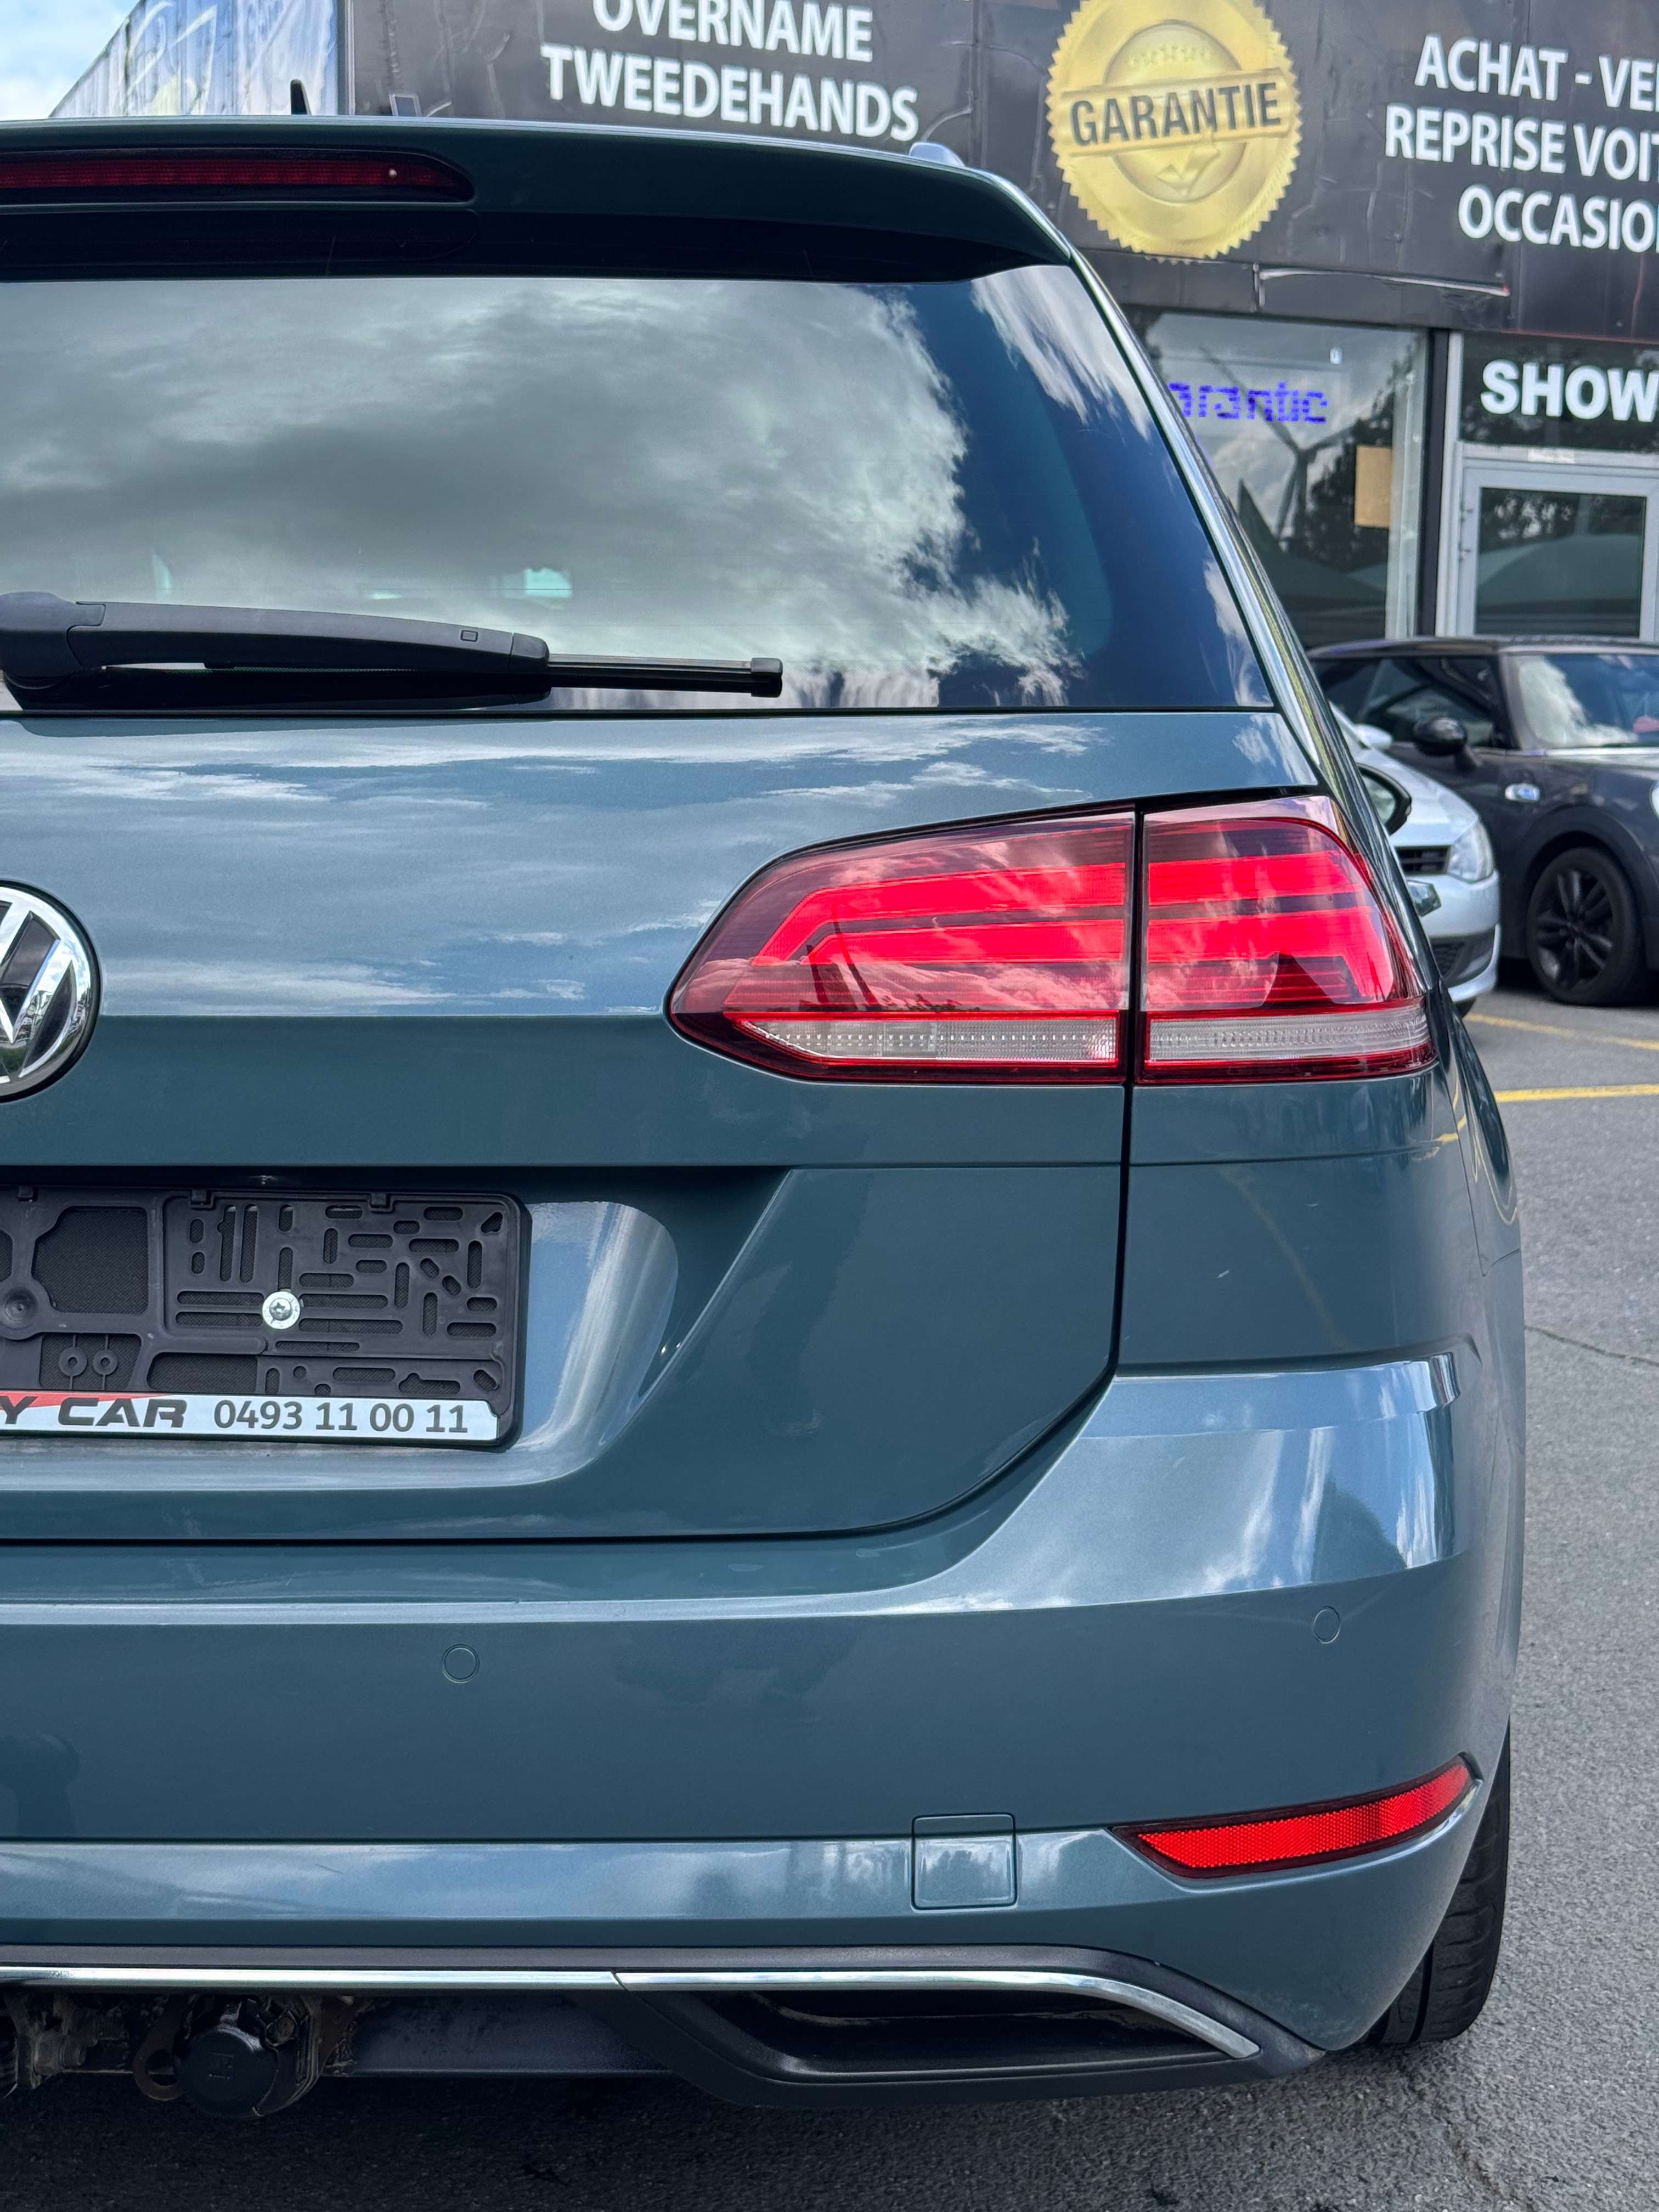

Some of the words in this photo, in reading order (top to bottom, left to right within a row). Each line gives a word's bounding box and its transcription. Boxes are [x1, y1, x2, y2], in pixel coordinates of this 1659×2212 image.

[592, 0, 873, 63] OVERNAME
[540, 43, 919, 142] TWEEDEHANDS
[1414, 32, 1568, 101] ACHAT
[1599, 54, 1659, 112] VE
[1070, 82, 1282, 146] GARANTIE
[1385, 103, 1567, 173] REPRISE
[1458, 184, 1659, 253] OCCASIO
[1480, 359, 1659, 422] SHOW
[58, 1397, 188, 1428] CAR
[213, 1400, 303, 1430] 0493
[315, 1402, 358, 1431] 11
[369, 1402, 415, 1432] 00
[425, 1404, 469, 1434] 11
